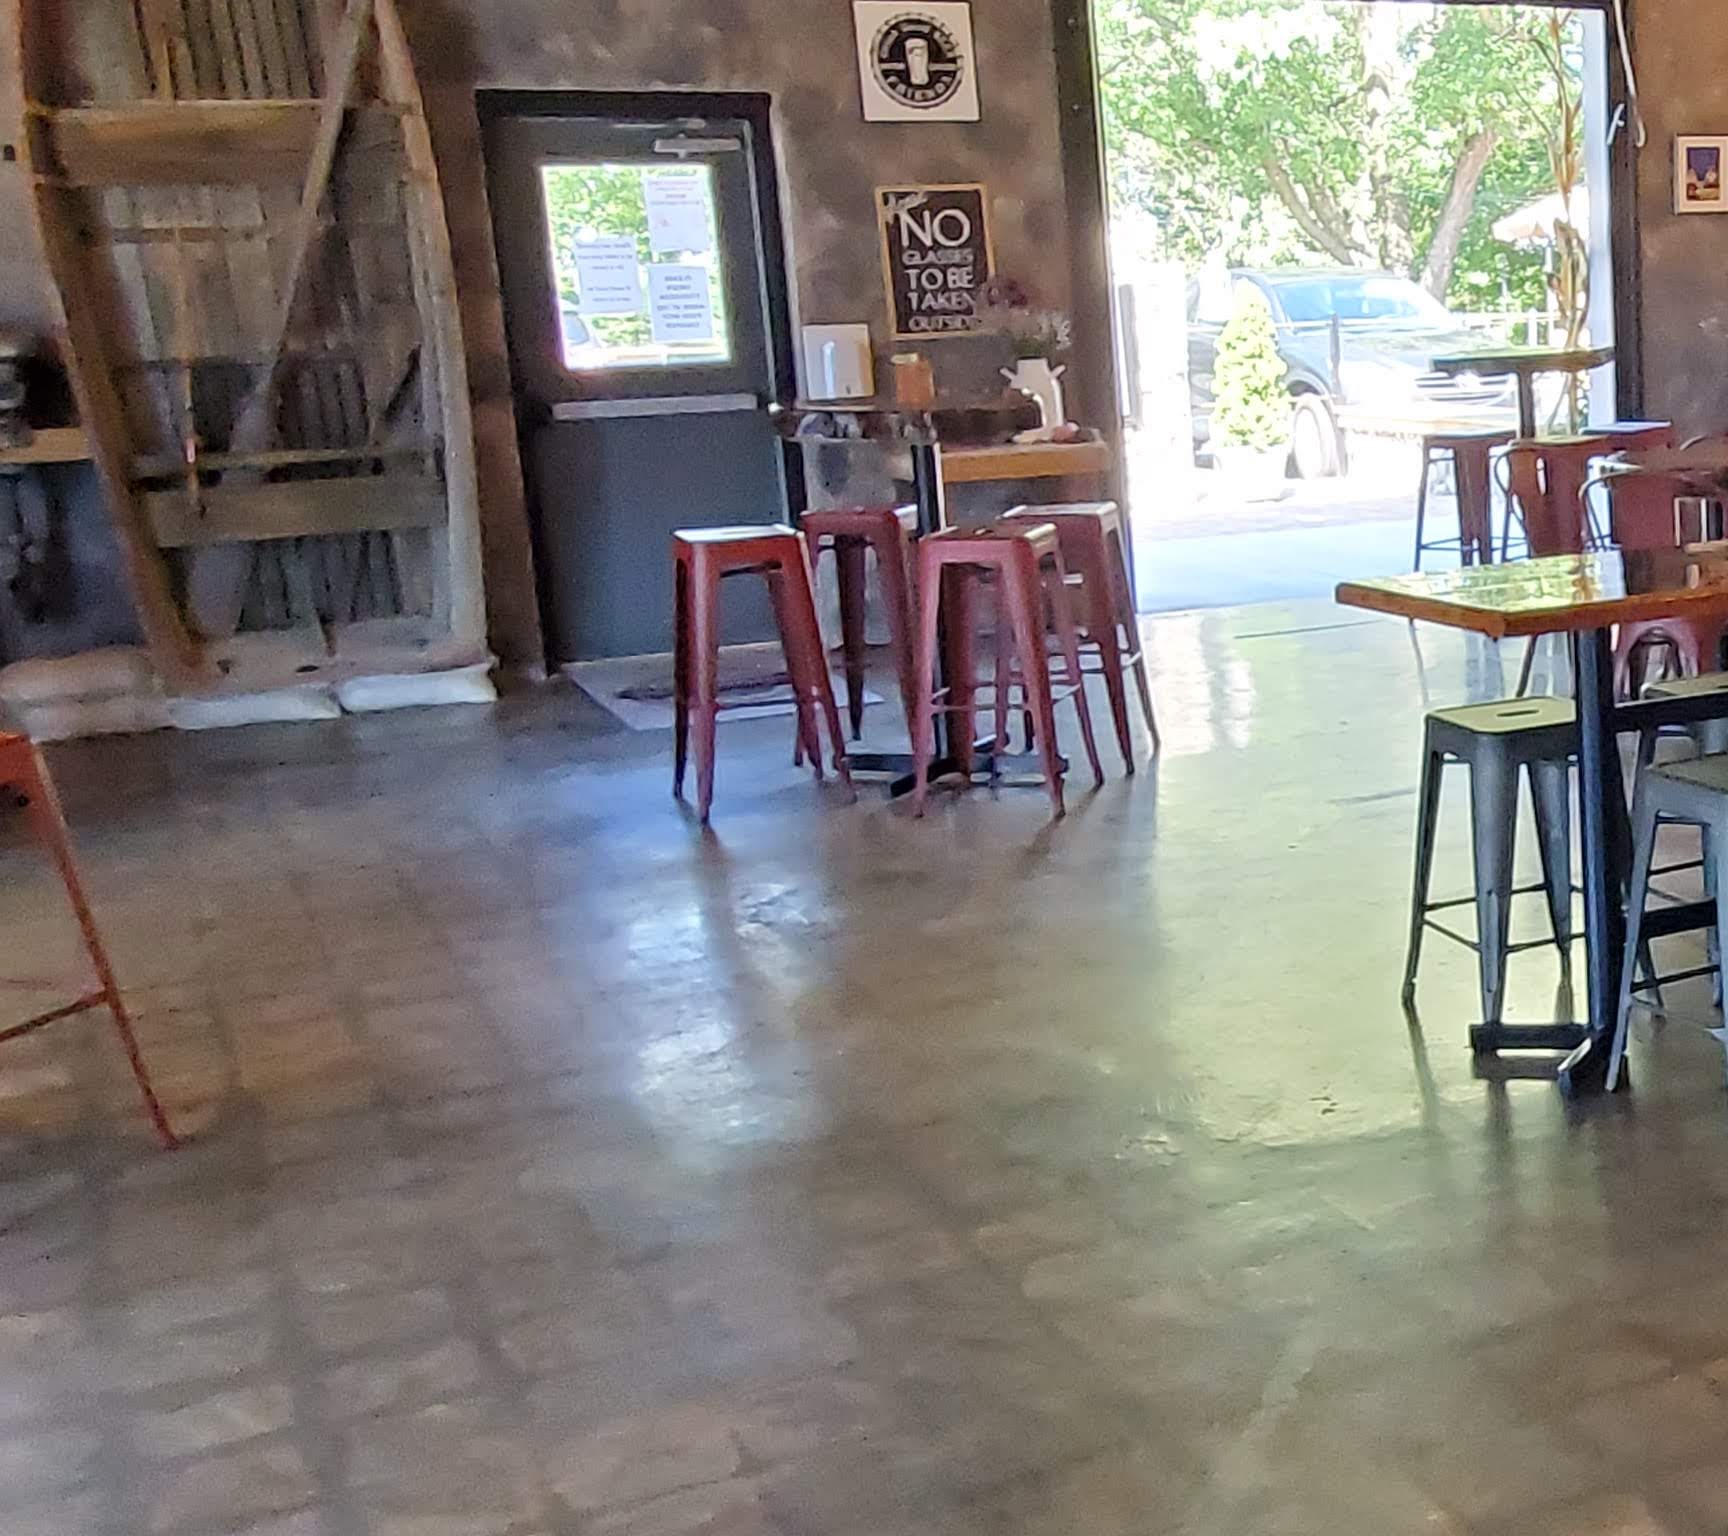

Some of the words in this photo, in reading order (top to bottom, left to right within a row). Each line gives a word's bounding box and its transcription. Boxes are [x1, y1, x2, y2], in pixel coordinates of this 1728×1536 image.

[899, 208, 971, 248] NO
[904, 268, 944, 290] TO
[946, 266, 975, 289] BE
